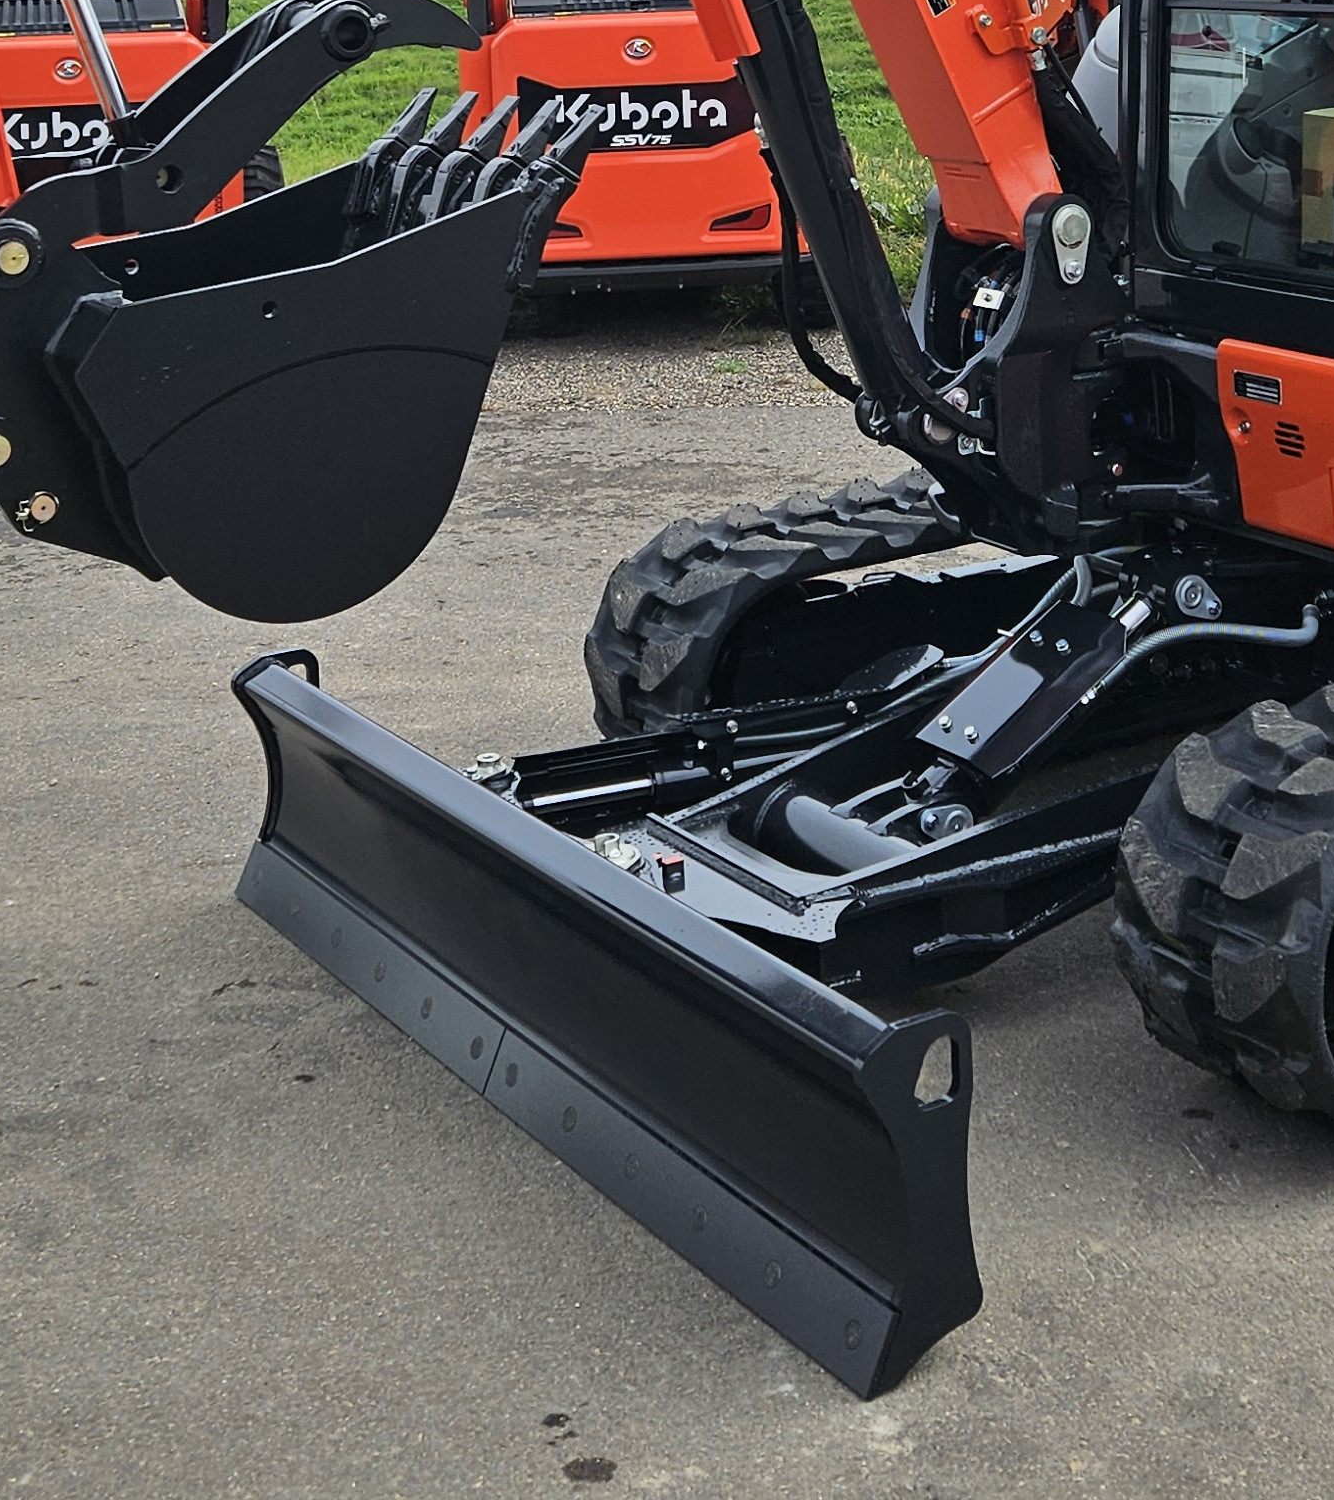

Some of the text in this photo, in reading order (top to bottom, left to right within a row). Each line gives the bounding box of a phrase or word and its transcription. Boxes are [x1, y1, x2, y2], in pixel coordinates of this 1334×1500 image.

[555, 89, 727, 132] Kubota
[4, 111, 109, 150] Kubo
[610, 133, 672, 147] SSV75
